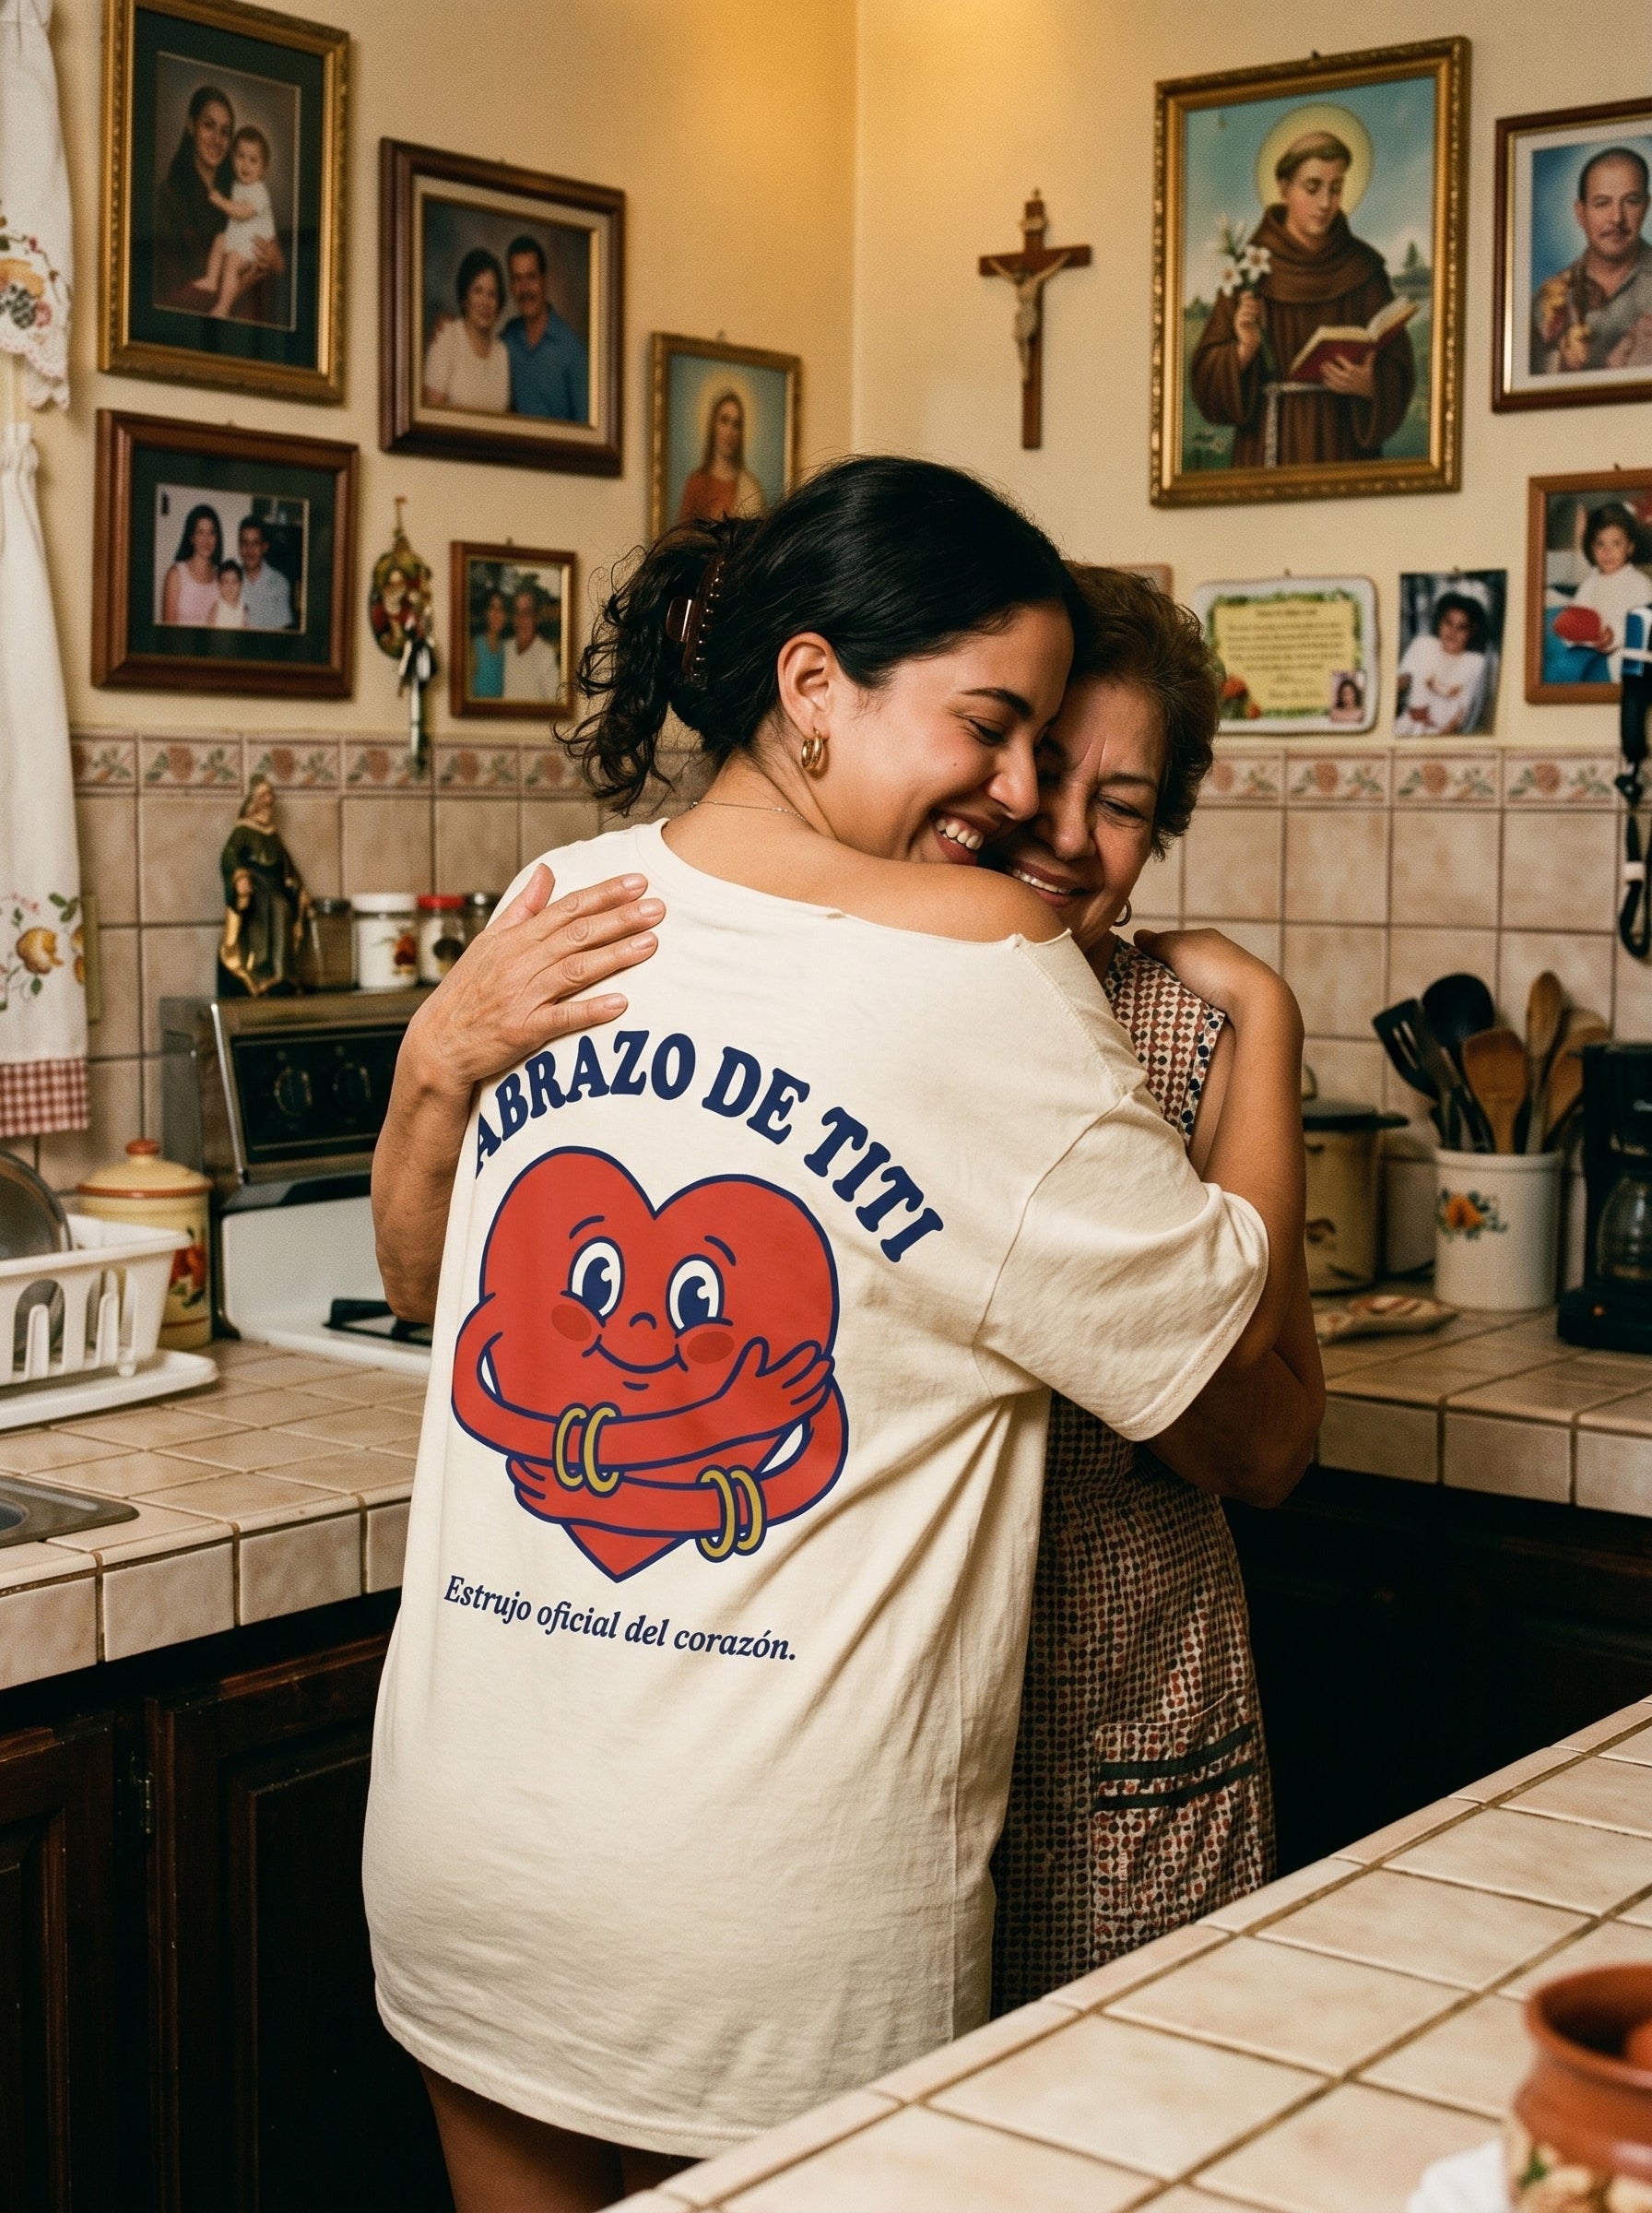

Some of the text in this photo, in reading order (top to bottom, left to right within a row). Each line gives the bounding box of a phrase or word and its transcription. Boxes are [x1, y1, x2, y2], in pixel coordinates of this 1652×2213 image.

[475, 1029, 944, 1263] ABRAZO DE TITI
[443, 1575, 796, 1661] Estrujo oficial del corazón.
